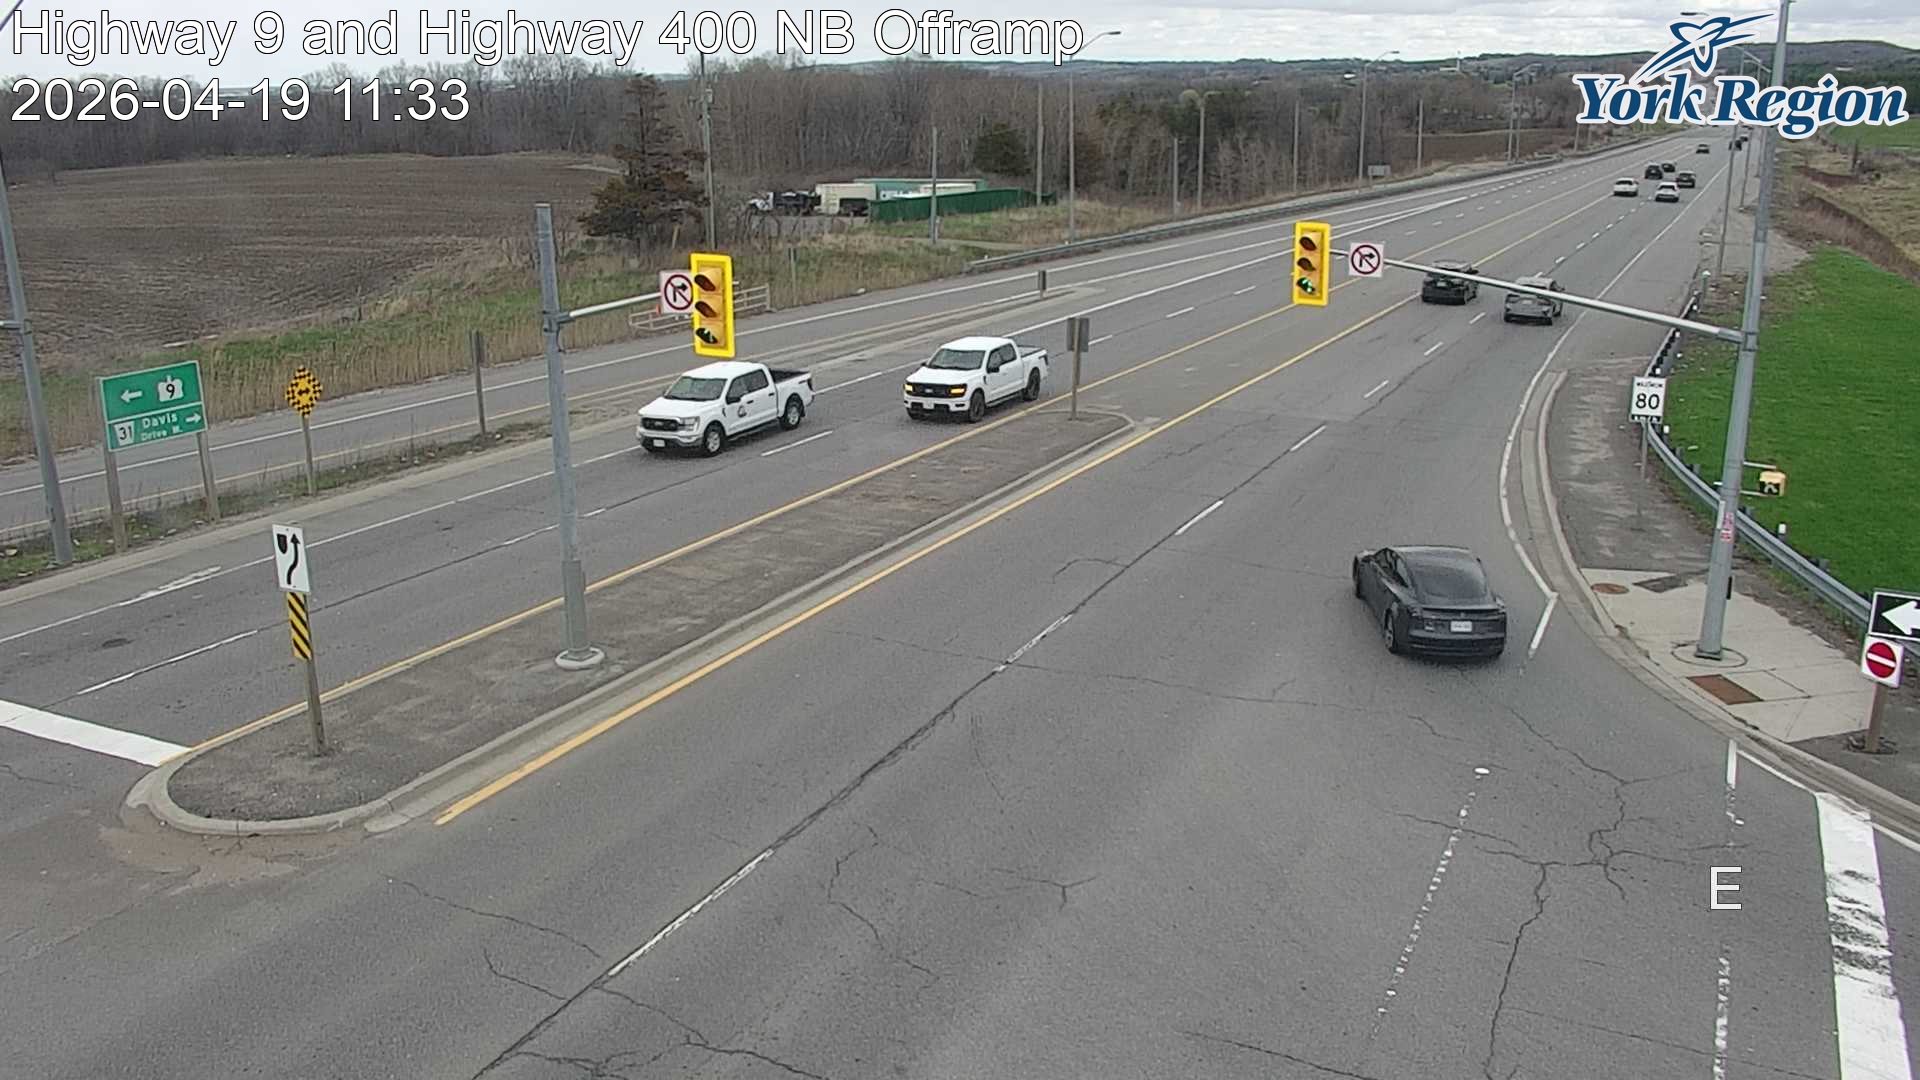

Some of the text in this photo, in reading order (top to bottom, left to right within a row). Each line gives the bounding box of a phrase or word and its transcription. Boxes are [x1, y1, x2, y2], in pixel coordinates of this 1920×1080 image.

[165, 383, 175, 399] 9
[1635, 393, 1660, 410] 80
[142, 412, 178, 429] Davis
[119, 425, 133, 441] 31
